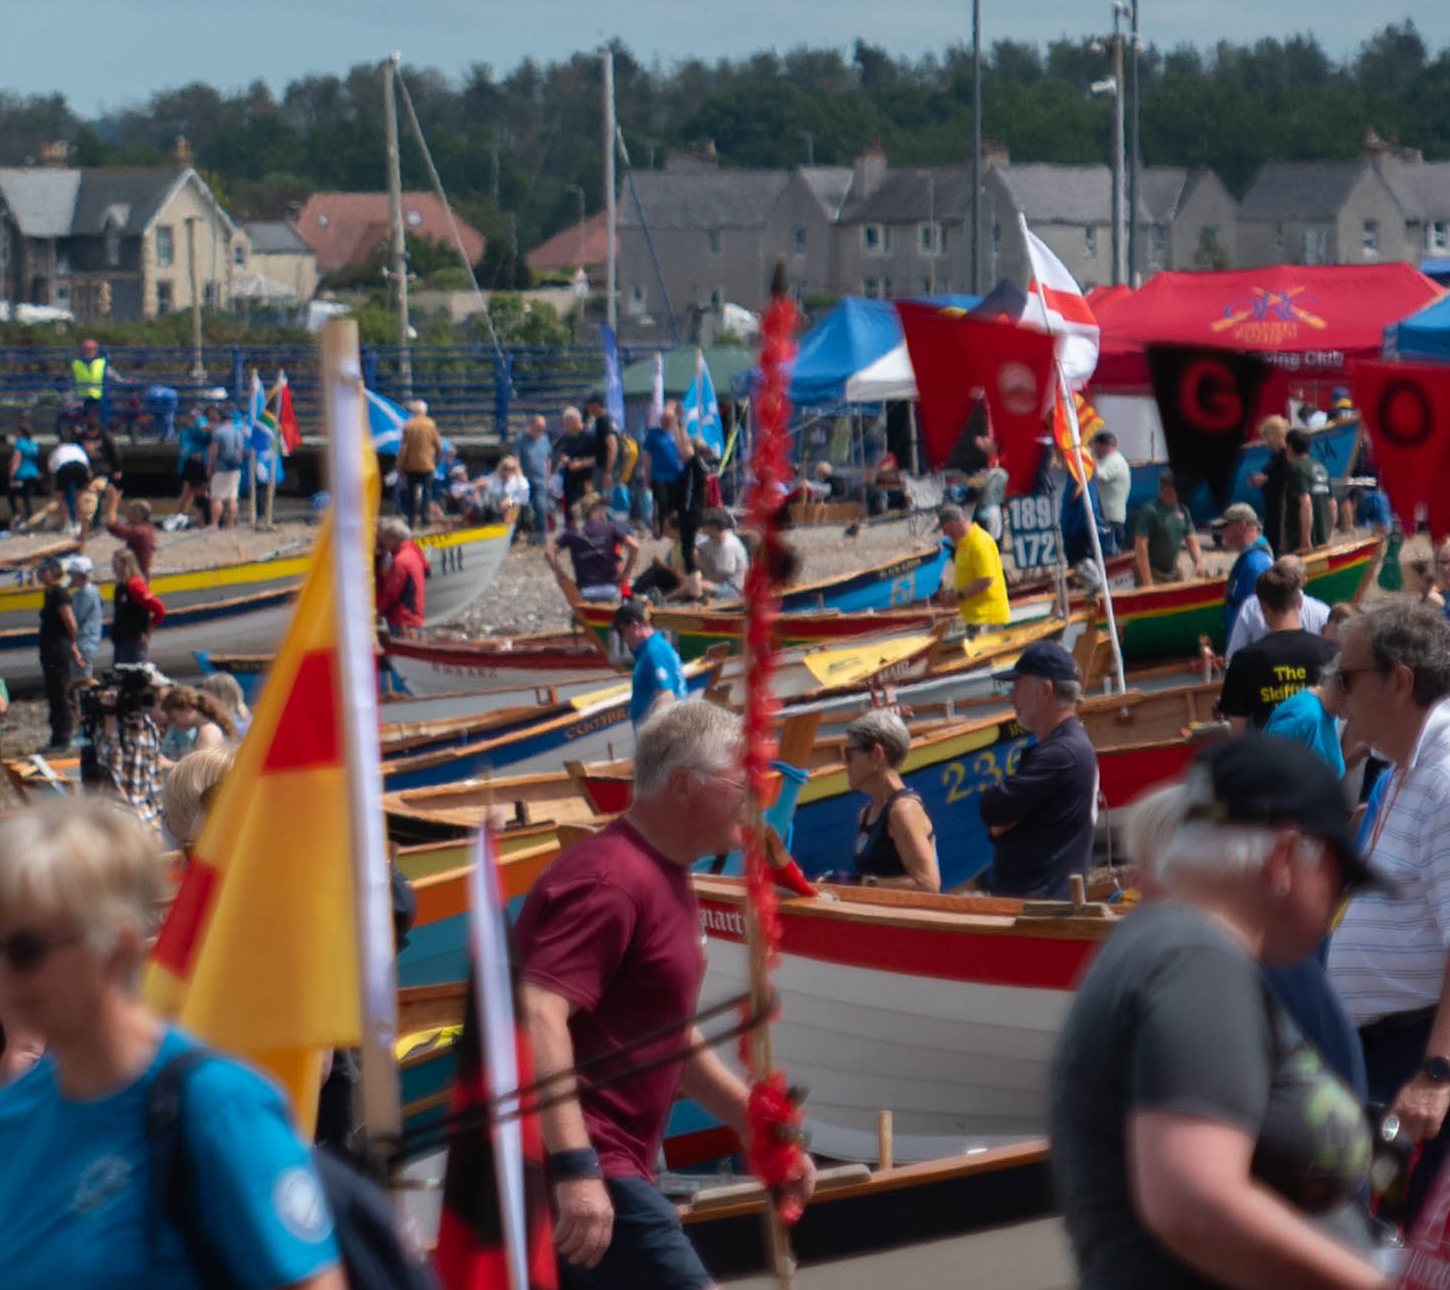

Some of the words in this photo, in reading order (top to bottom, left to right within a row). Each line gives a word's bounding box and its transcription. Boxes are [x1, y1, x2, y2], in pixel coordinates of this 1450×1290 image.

[1305, 350, 1345, 366] Club
[1180, 359, 1244, 433] G
[1009, 495, 1051, 530] 189
[1014, 530, 1059, 568] 172
[1273, 665, 1307, 681] The
